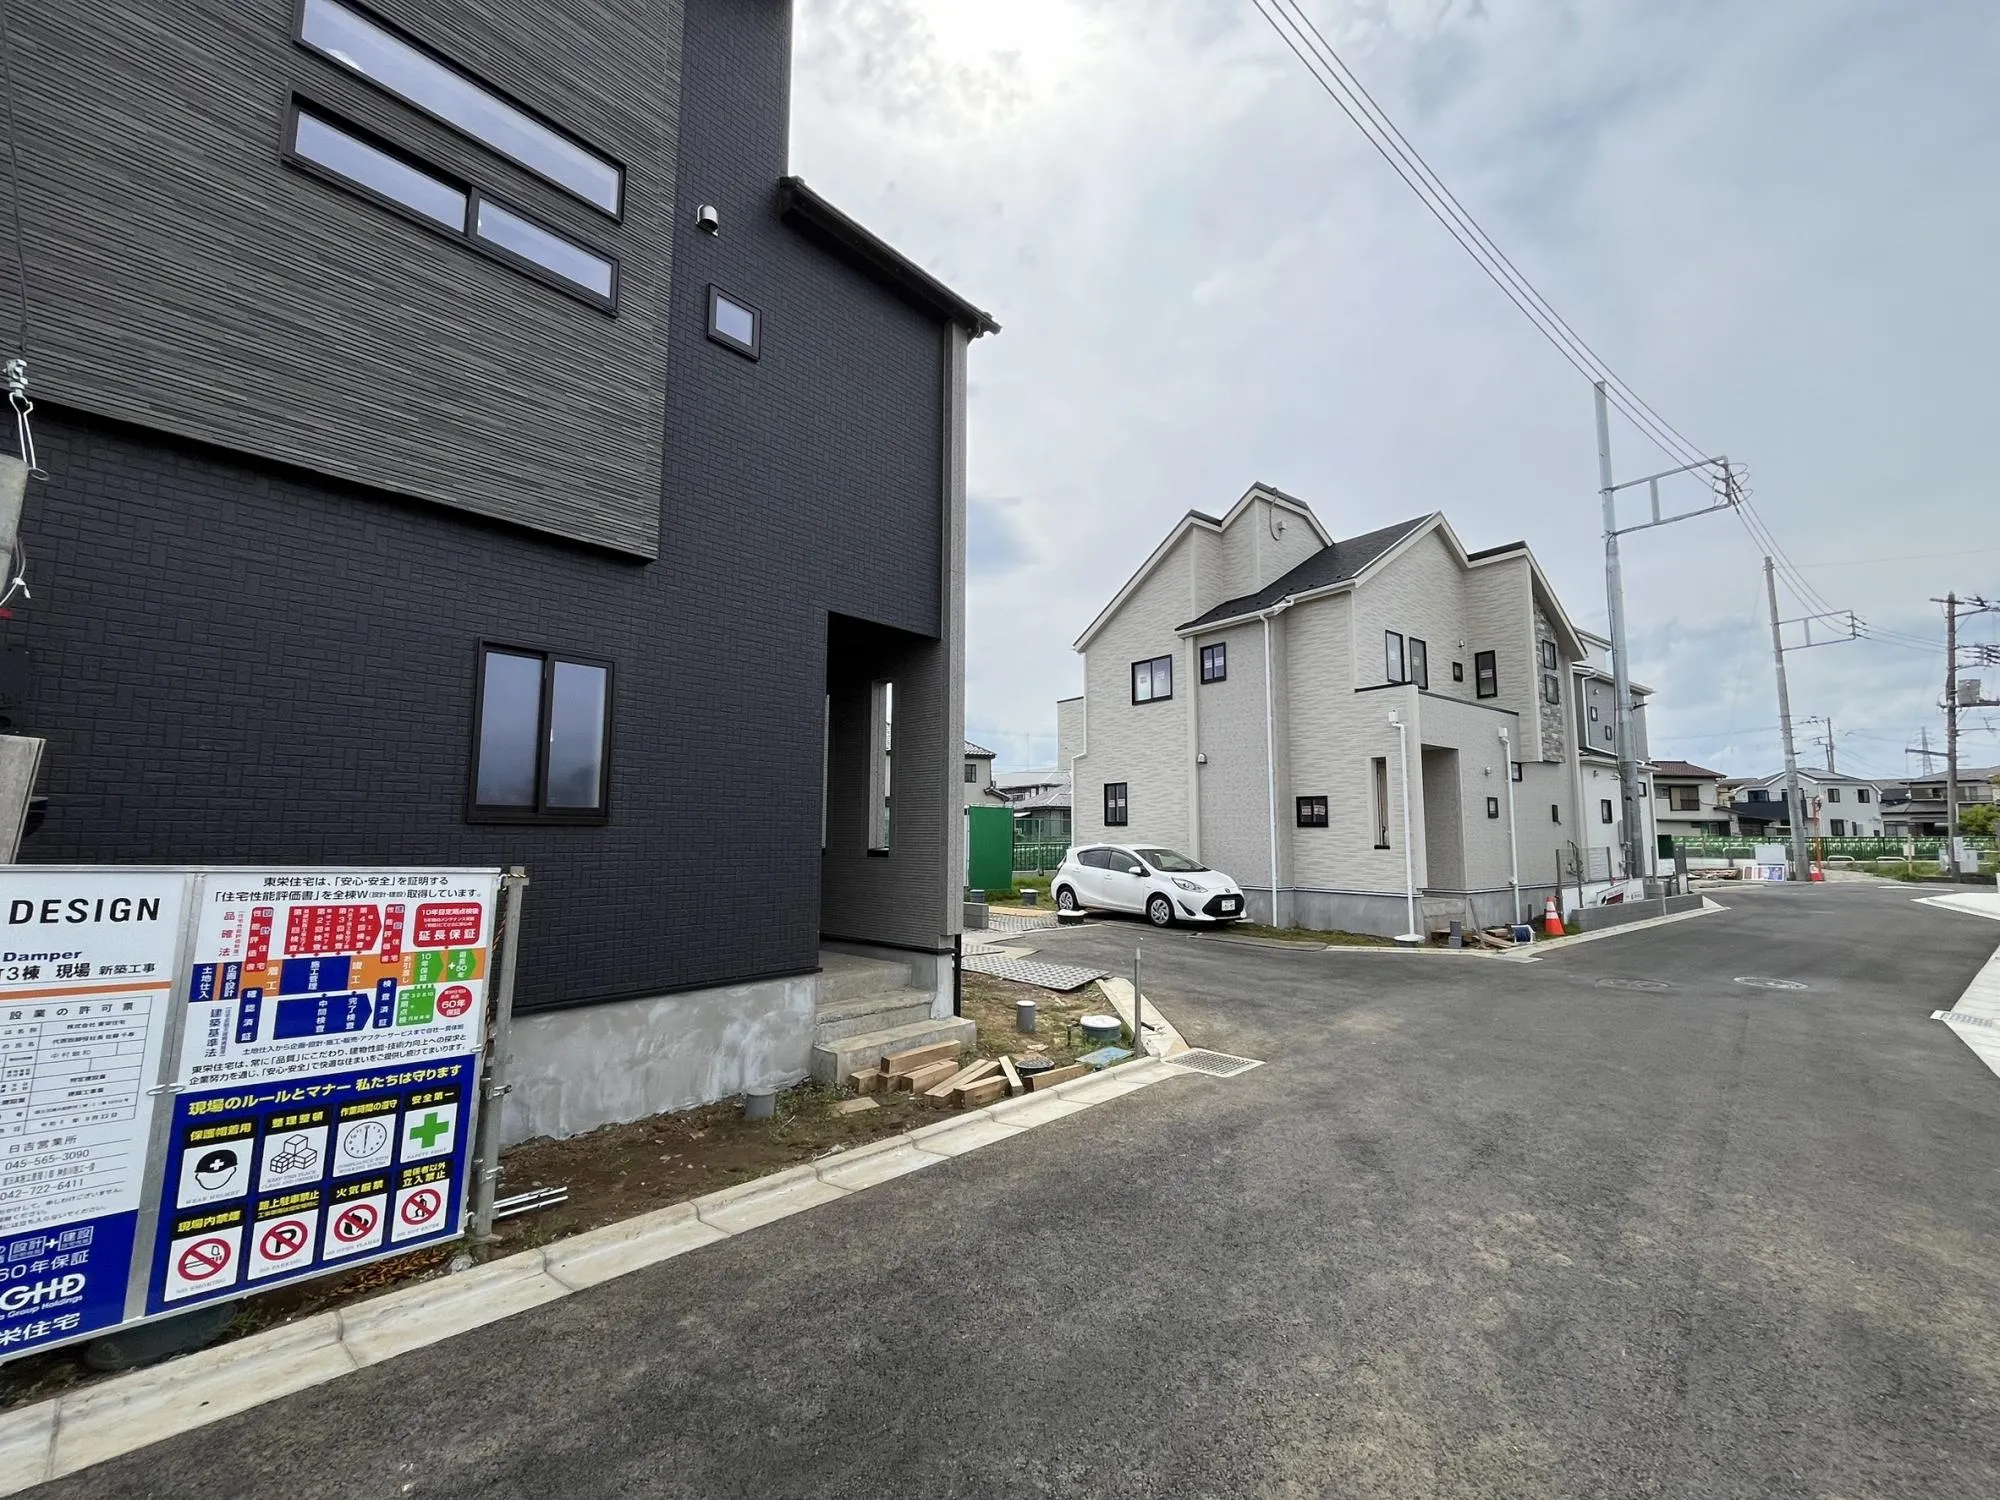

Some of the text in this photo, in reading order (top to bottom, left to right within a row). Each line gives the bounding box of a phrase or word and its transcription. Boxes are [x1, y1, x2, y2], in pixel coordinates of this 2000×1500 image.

[264, 876, 448, 887] 東栄住宅は、「安心・安全」を証明する
[9, 898, 160, 924] DESIGN
[418, 928, 476, 941] 延長保証
[3, 951, 82, 962] Damper
[0, 963, 155, 981] 3棟 現場 新築工事
[199, 966, 212, 999] 土地仕入
[345, 997, 358, 1029] 完了検査
[378, 980, 392, 1026] 検査済証
[442, 1000, 466, 1009] 60年
[241, 990, 257, 1041] 確認済証
[315, 1000, 328, 1033] 中間検査
[204, 1008, 222, 1058] 建築基準法
[188, 1064, 462, 1116] 現場のルールとマナー 私たちは守ります
[411, 1091, 455, 1105] 安全第一
[9, 1135, 77, 1154] 日吉営業所
[5, 1149, 90, 1171] 045-565-3090
[403, 1161, 446, 1178] 関係者以外
[0, 1178, 84, 1201] 042-722-6411
[336, 1179, 384, 1198] 火気厳禁
[402, 1171, 446, 1187] 立入禁止
[177, 1210, 241, 1232] 現場内禁煙
